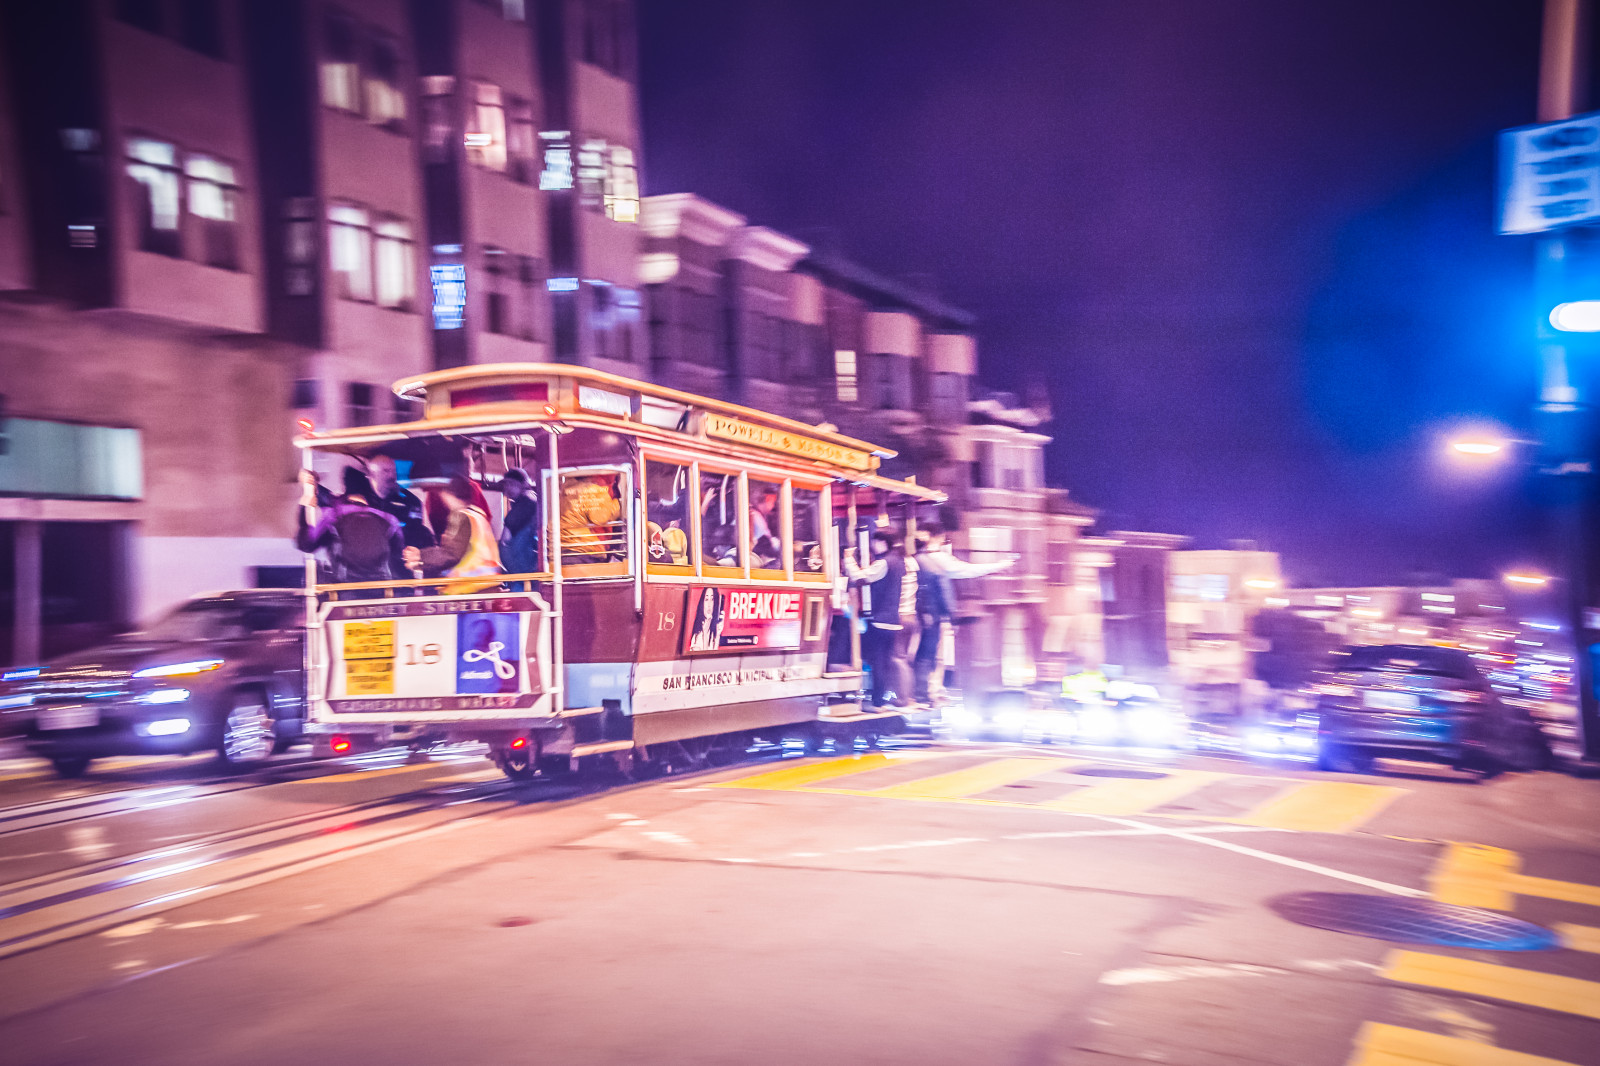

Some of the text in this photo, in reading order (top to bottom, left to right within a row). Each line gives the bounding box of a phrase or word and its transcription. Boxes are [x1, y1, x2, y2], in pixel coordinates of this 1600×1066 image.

[715, 420, 777, 445] POWELL
[423, 599, 495, 614] STREET
[729, 592, 774, 619] BREAK
[657, 612, 676, 631] 18
[404, 643, 442, 665] 18
[662, 676, 682, 690] SAN
[684, 672, 733, 690] FRANCISCO
